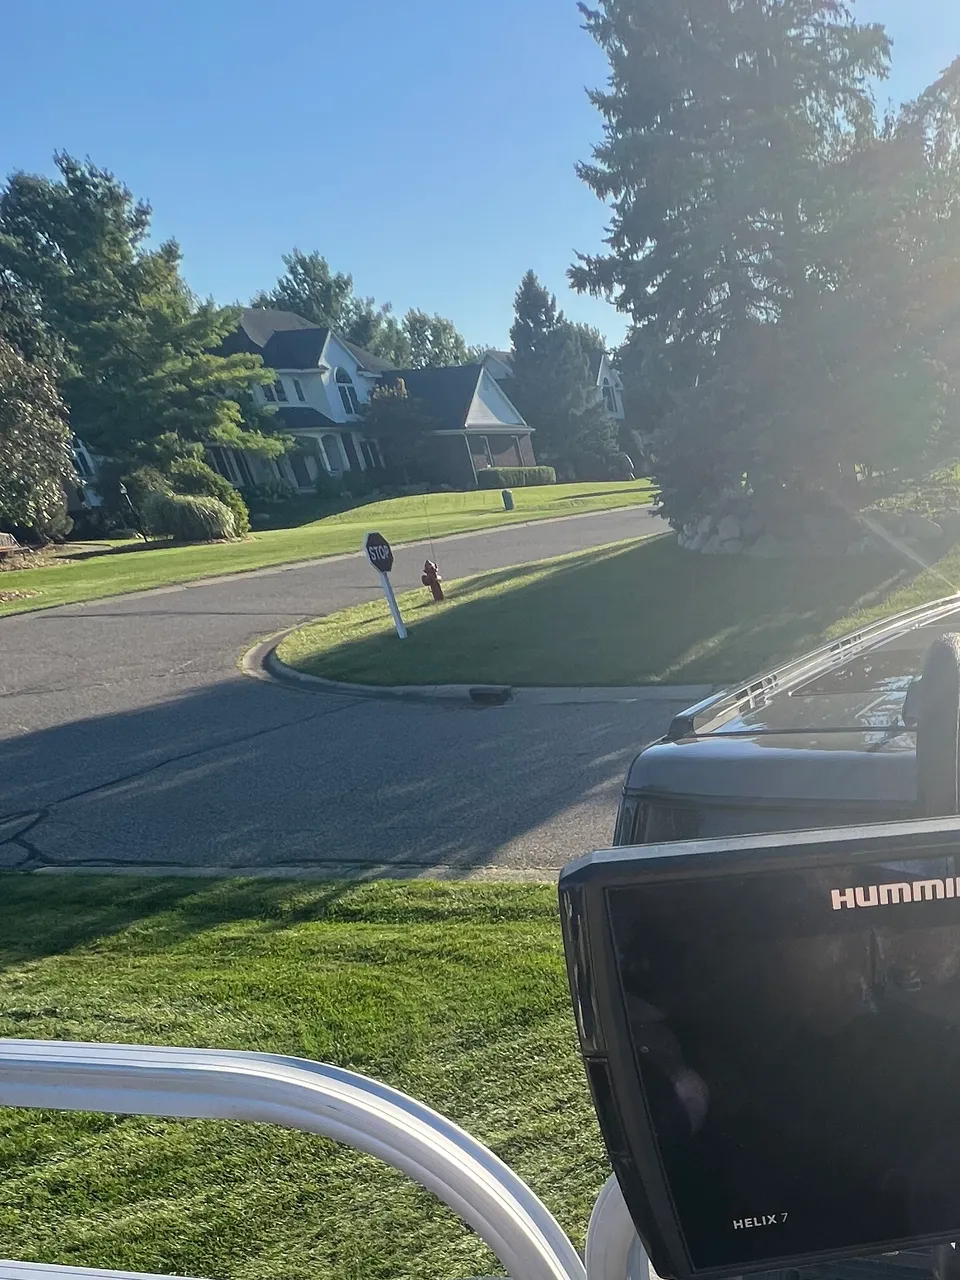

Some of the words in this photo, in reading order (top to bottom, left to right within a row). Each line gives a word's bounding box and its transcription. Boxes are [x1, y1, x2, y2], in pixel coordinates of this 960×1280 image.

[368, 545, 390, 561] STOP
[733, 1214, 777, 1230] HELIX
[780, 1212, 789, 1223] 7
